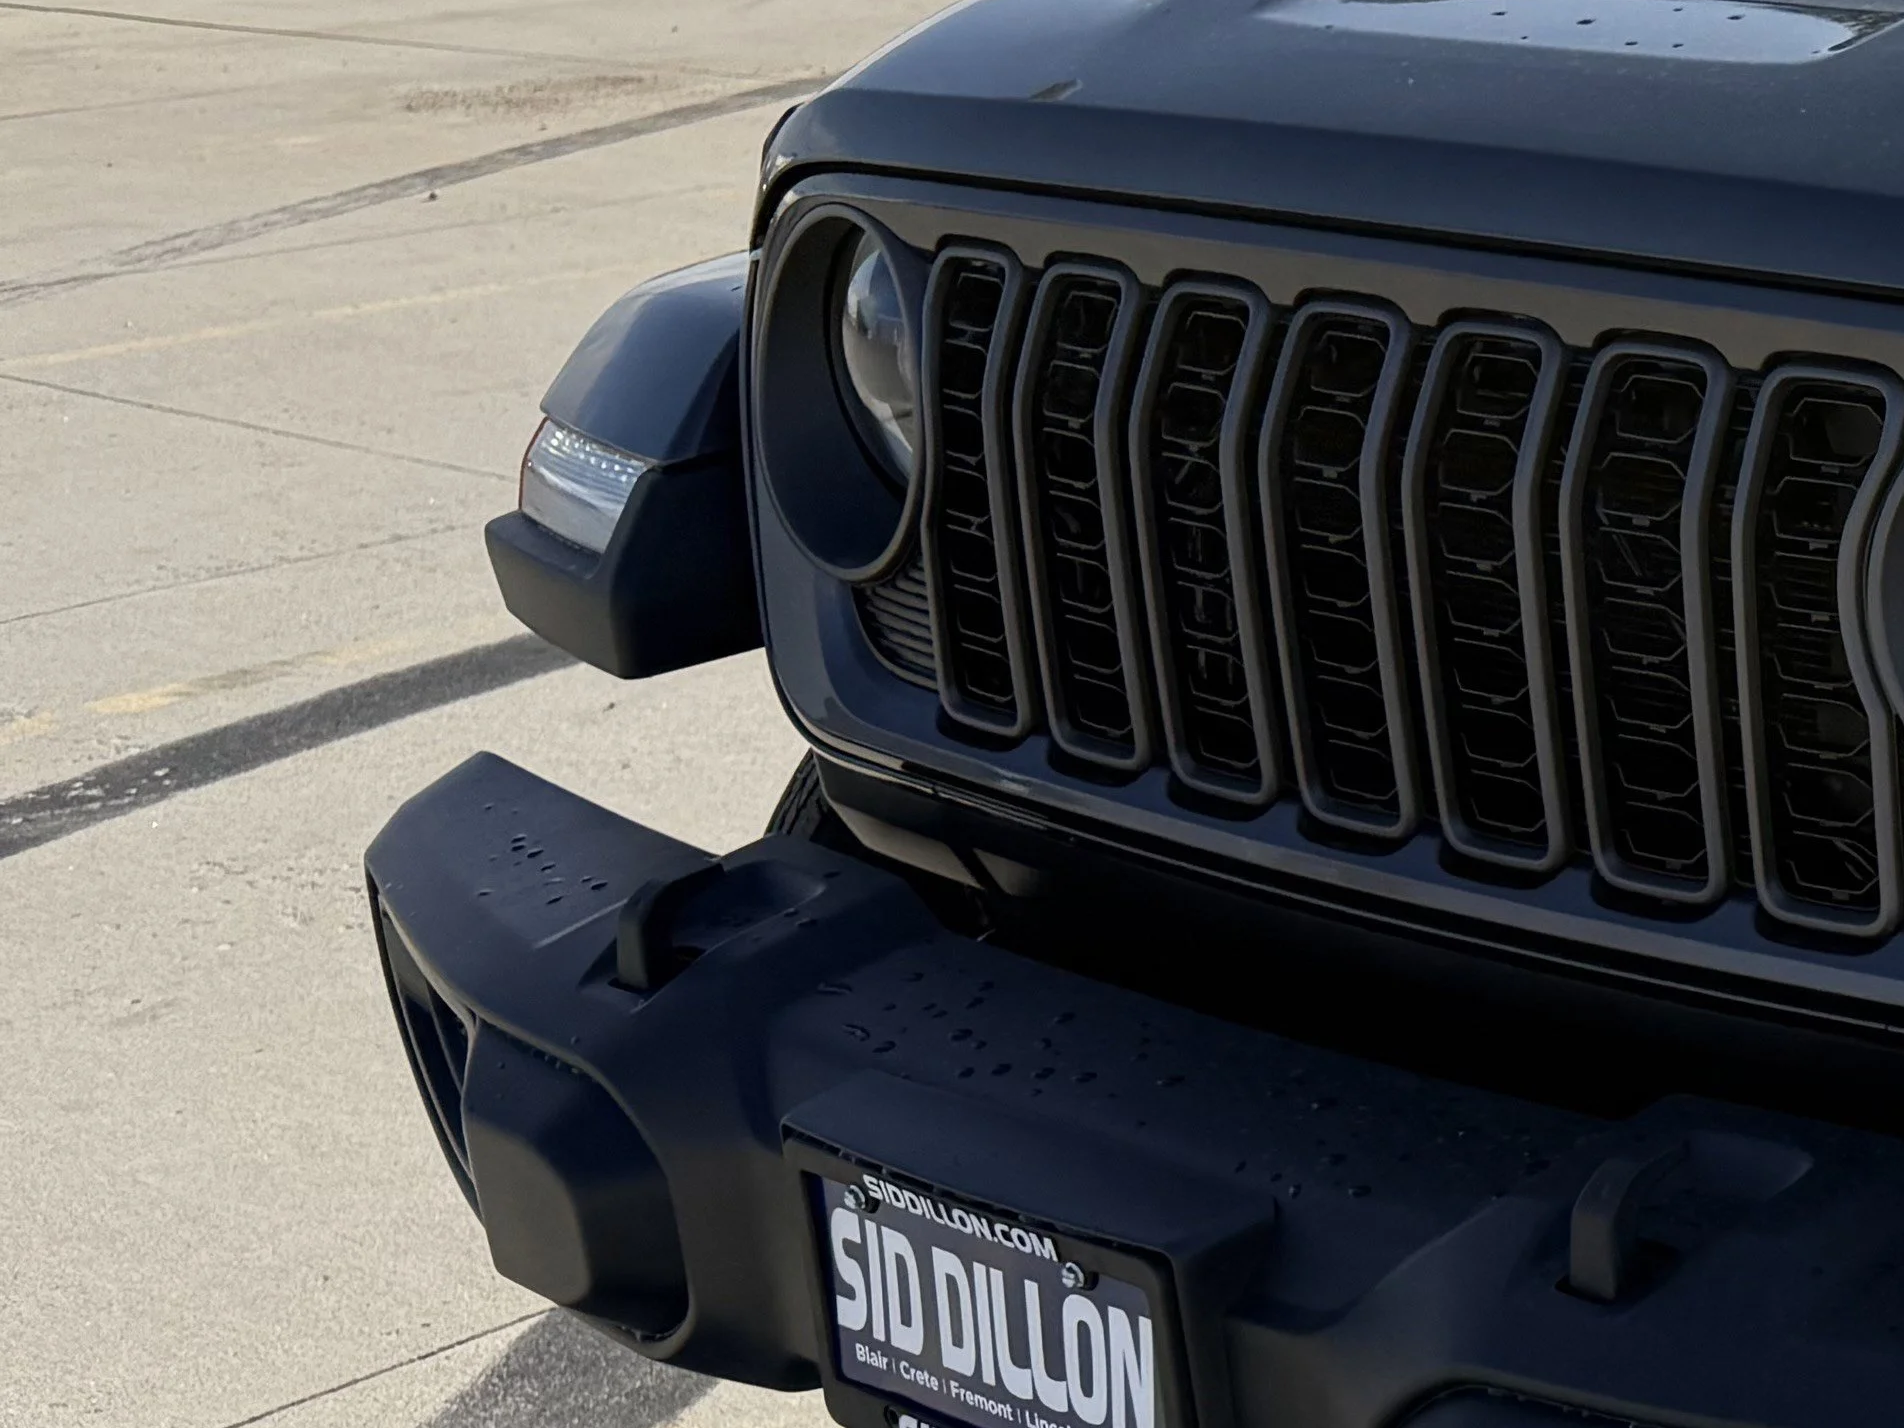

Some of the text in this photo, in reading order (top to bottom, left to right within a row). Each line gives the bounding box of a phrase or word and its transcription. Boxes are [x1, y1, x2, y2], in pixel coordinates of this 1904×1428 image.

[862, 1173, 1059, 1263] SIDDILLON.COM
[830, 1206, 924, 1356] SID
[855, 1342, 889, 1372] Blair
[899, 1359, 940, 1391] Crete
[951, 1380, 1013, 1421] Fremont
